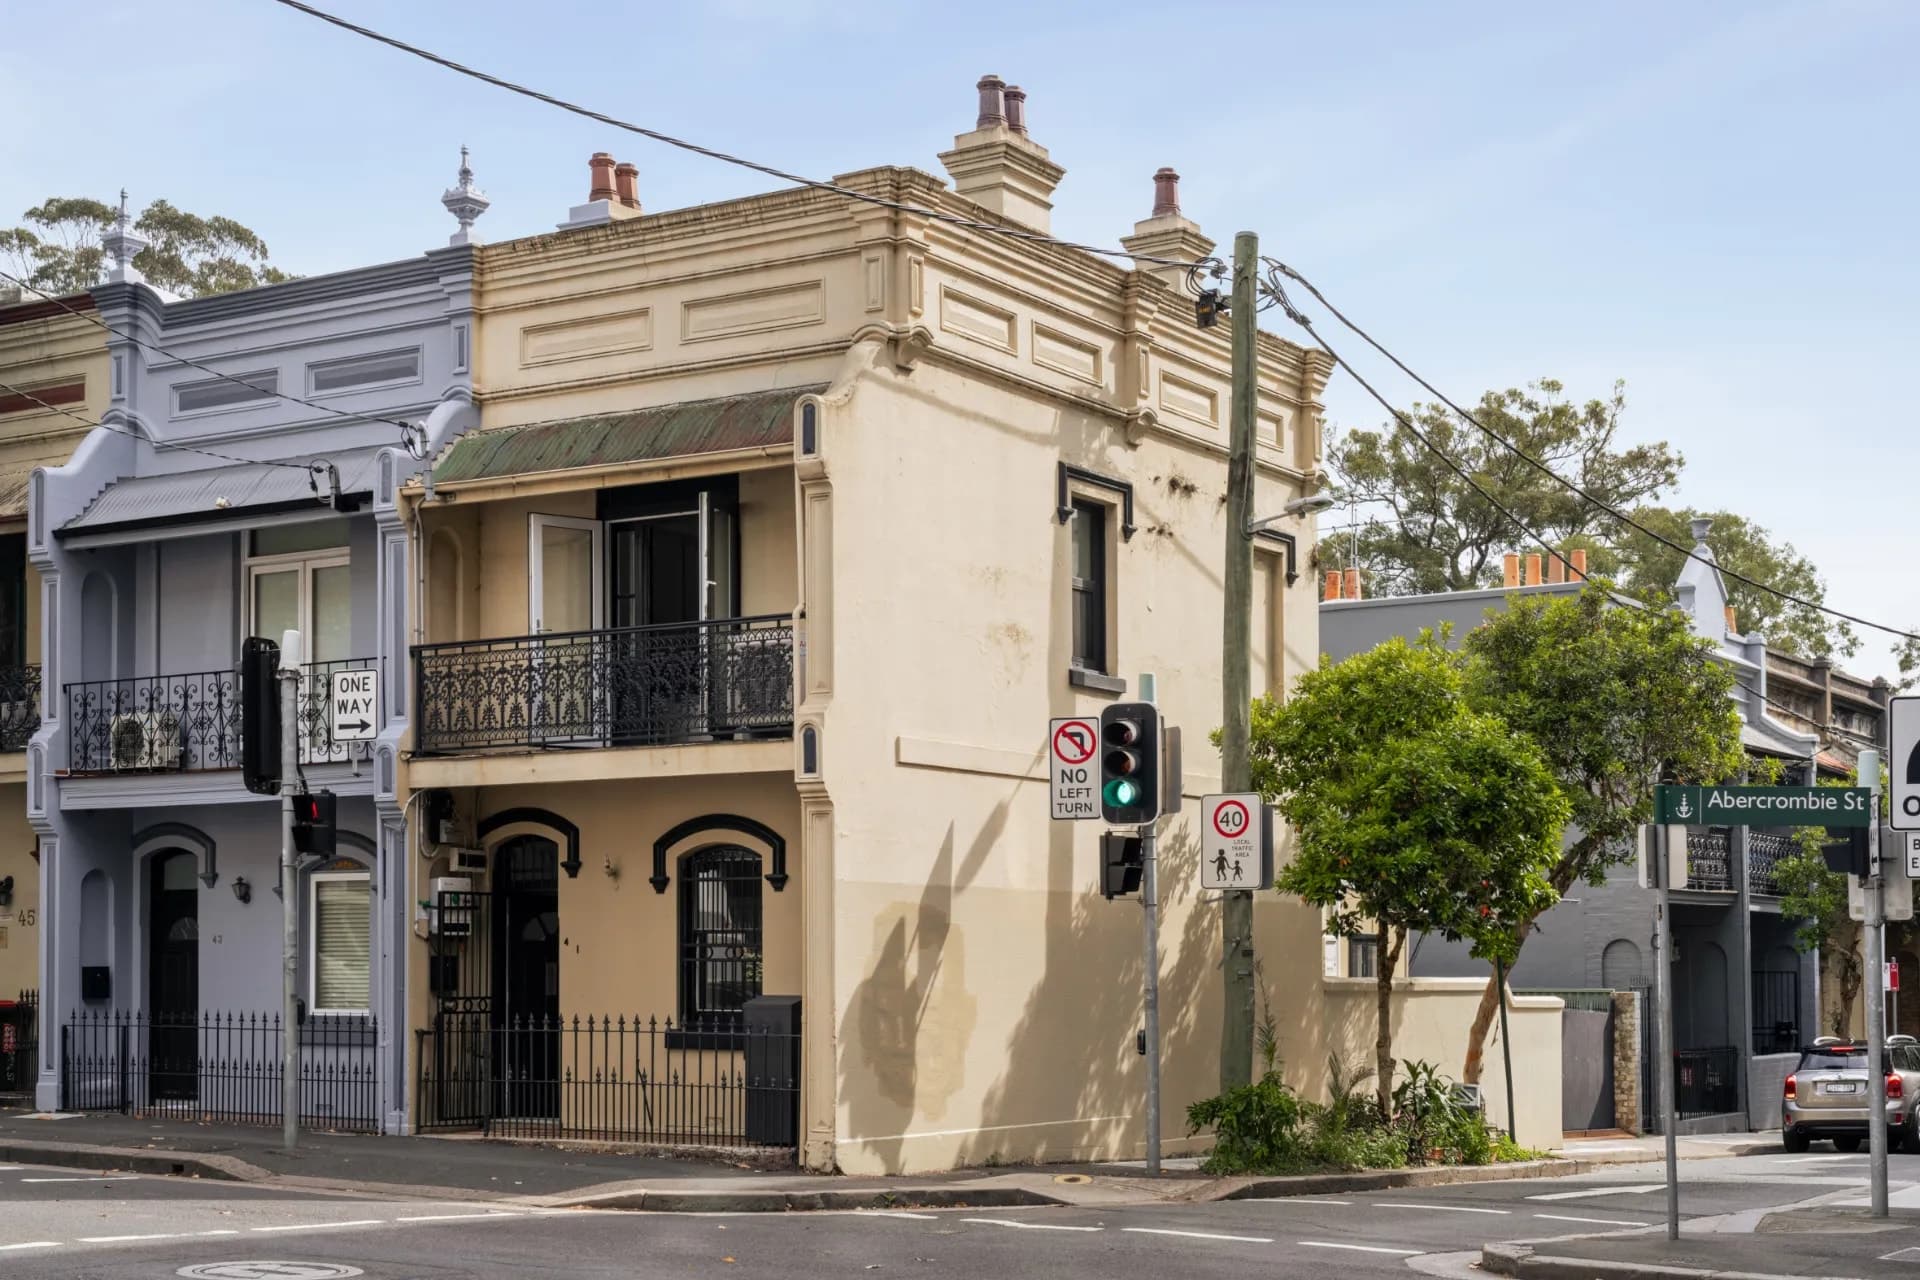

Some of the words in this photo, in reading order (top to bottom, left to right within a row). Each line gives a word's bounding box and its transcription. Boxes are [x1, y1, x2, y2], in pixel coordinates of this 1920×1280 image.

[340, 676, 371, 693] ONE
[337, 698, 372, 715] WAY
[1061, 768, 1088, 784] NO
[1060, 787, 1092, 799] LEFT
[1707, 790, 1838, 810] Abercrombie
[1844, 791, 1865, 810] St
[1056, 802, 1093, 814] TURN
[1219, 811, 1243, 827] 40
[18, 909, 35, 926] 45
